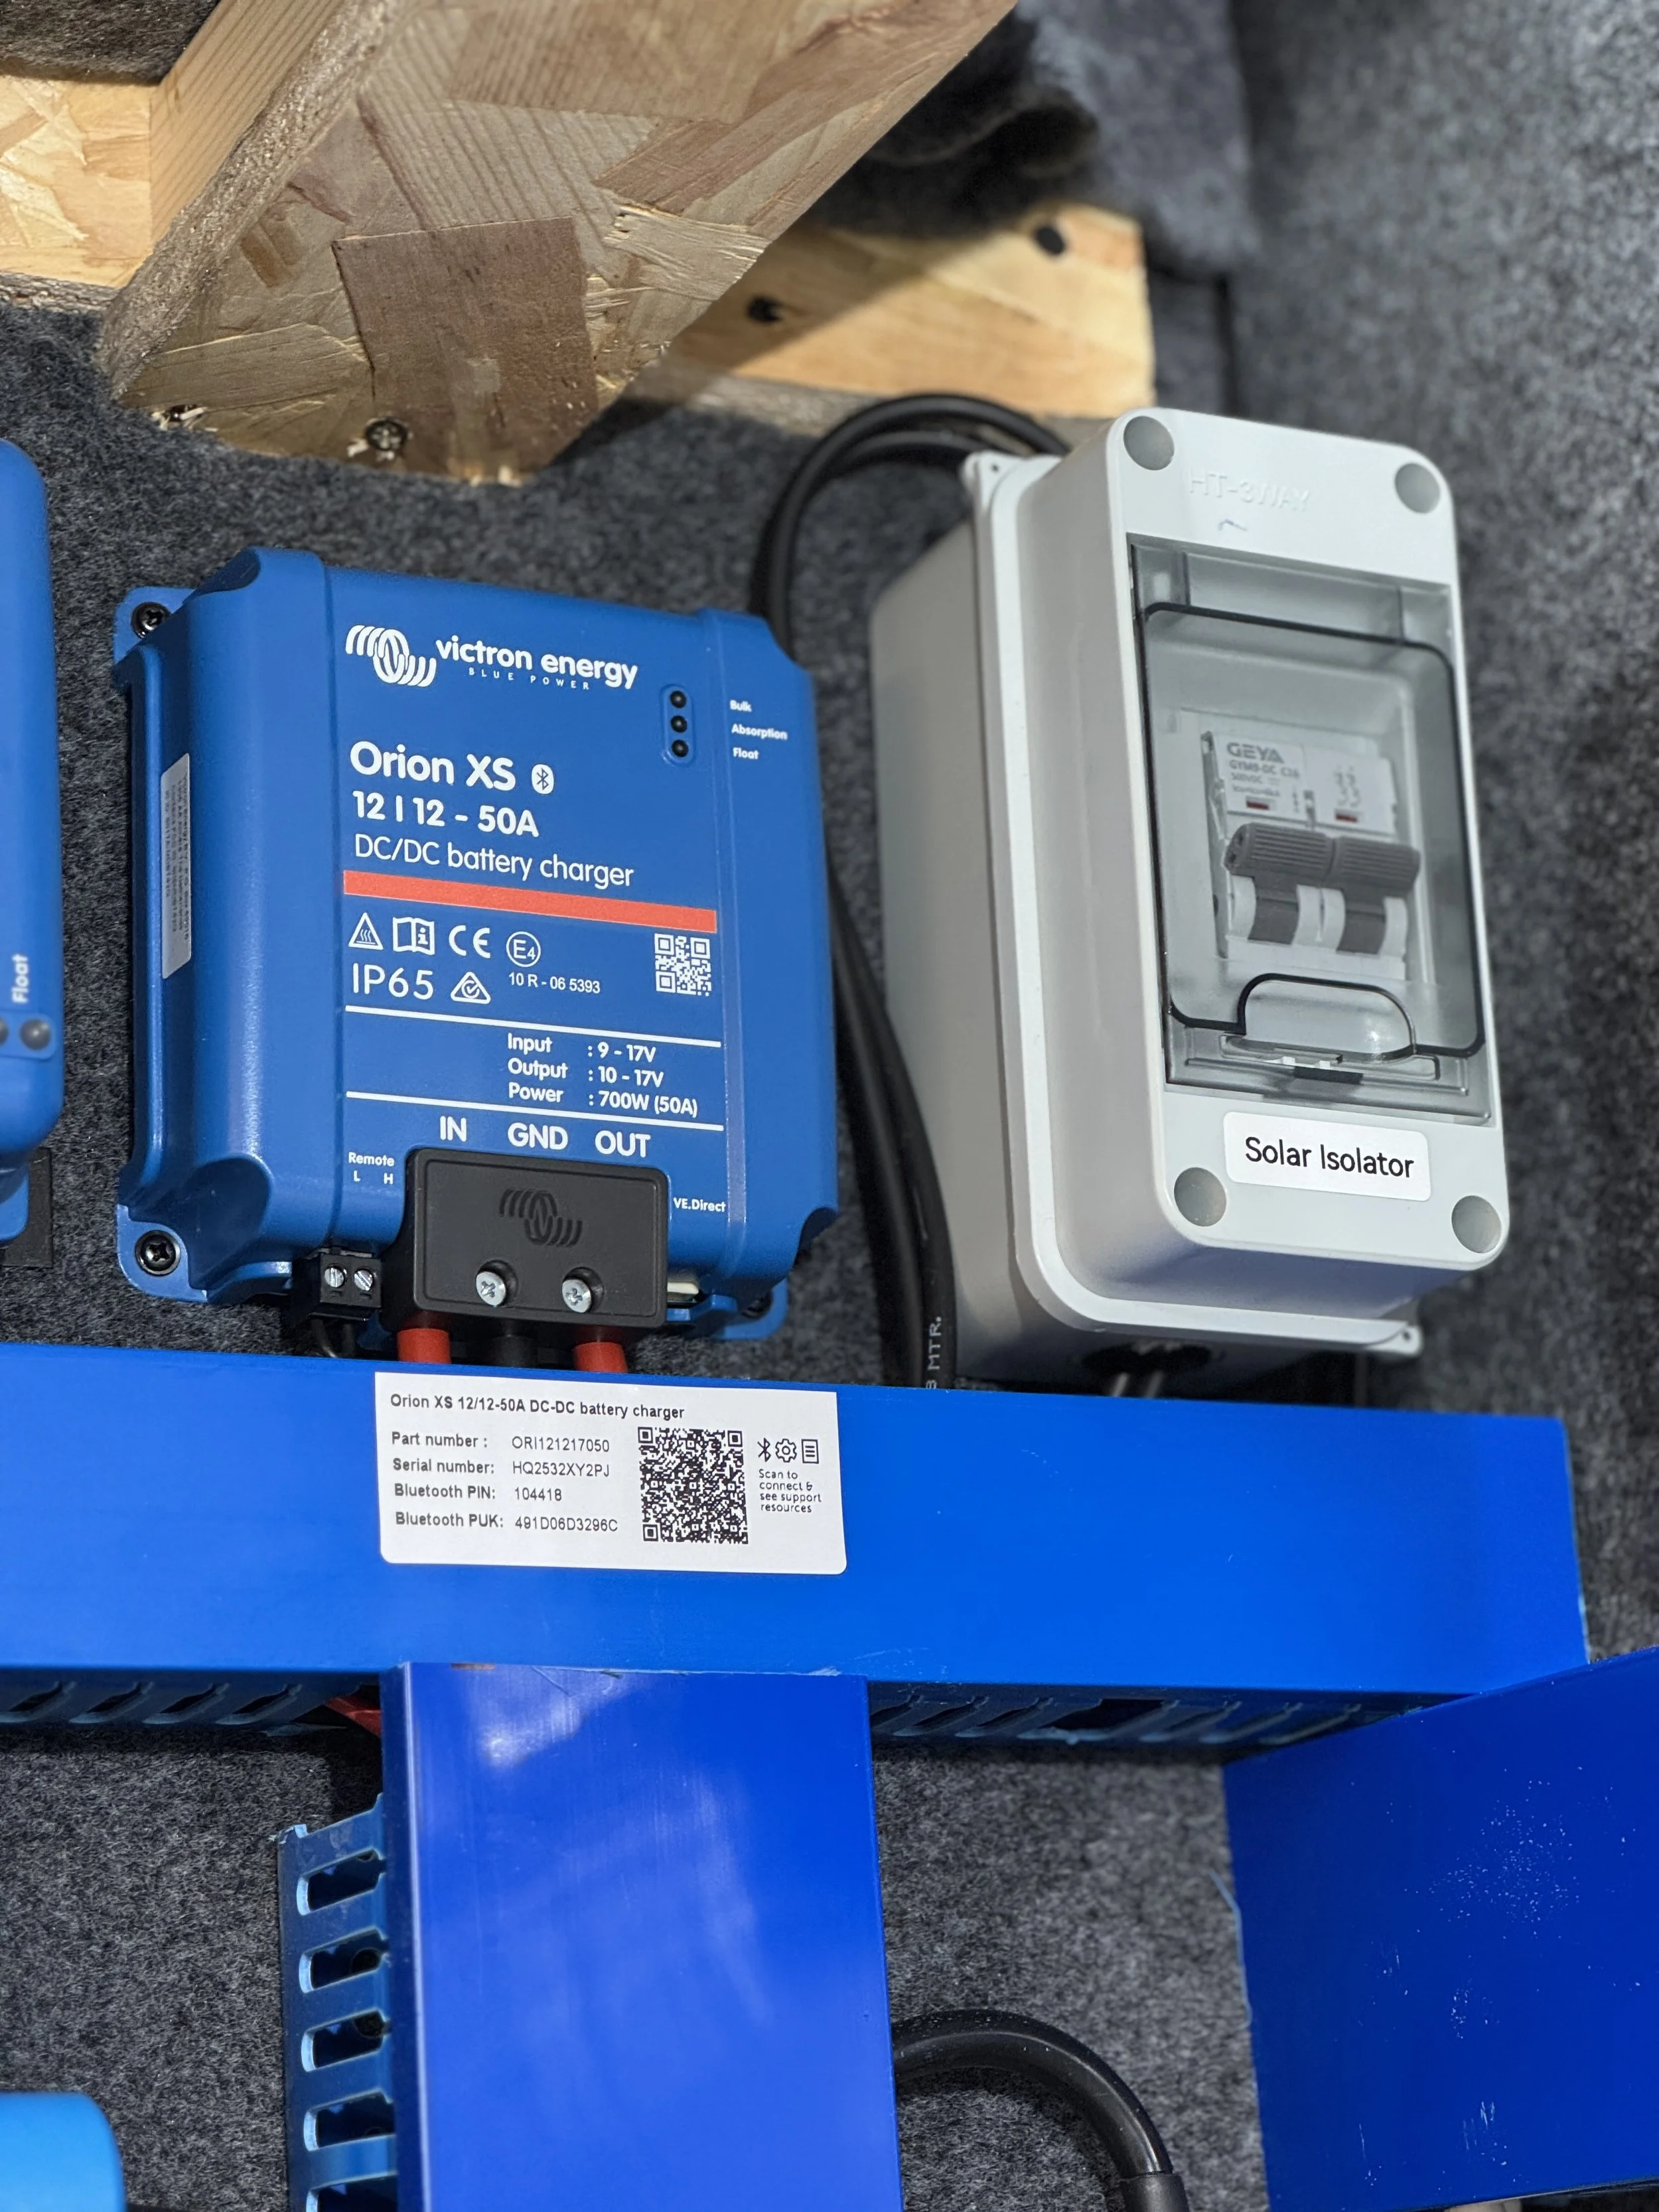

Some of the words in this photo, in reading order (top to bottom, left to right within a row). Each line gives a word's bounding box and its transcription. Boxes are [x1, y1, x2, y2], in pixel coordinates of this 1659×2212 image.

[435, 634, 533, 670] victron
[540, 654, 638, 690] energy
[469, 667, 514, 681] BLUE
[530, 675, 589, 690] POWER
[730, 700, 752, 712] Bulk
[731, 723, 788, 740] Absorption
[733, 747, 759, 760] Float
[1226, 742, 1284, 763] GEYA
[350, 741, 455, 784] Orion
[466, 754, 516, 791] XS
[352, 790, 386, 820] 12
[412, 797, 445, 827] 12
[477, 805, 540, 838] 50A
[355, 833, 440, 865] DC/DC
[447, 842, 533, 881] battery
[540, 853, 634, 890] charger
[11, 954, 29, 1003] Float
[352, 963, 434, 1000] IP65
[508, 972, 524, 986] 10
[528, 974, 538, 988] R
[549, 976, 566, 990] 06
[569, 978, 601, 994] 5393
[508, 1033, 553, 1055] Input
[597, 1041, 609, 1059] 9
[626, 1044, 656, 1063] 17V
[508, 1057, 569, 1081] Output
[598, 1065, 617, 1084] 10
[634, 1069, 664, 1088] 17V
[508, 1082, 564, 1103] Power
[598, 1090, 650, 1111] 700W
[654, 1095, 698, 1118] (50A)
[440, 1116, 467, 1142] IN
[507, 1122, 568, 1150] GND
[595, 1130, 651, 1158] OUT
[348, 1151, 395, 1167] Remote
[1246, 1136, 1312, 1167] Solar
[1320, 1143, 1415, 1178] Isolator
[353, 1170, 360, 1182] L
[384, 1173, 394, 1185] H
[673, 1197, 727, 1213] VE.Direct
[927, 1316, 942, 1370] MTR.
[390, 1393, 429, 1408] Orion
[434, 1395, 453, 1409] XS
[458, 1396, 526, 1412] 12/12-50A
[530, 1399, 575, 1414] DC-DC
[580, 1401, 628, 1420] battery
[632, 1404, 685, 1422] charger
[392, 1431, 420, 1445] Part
[425, 1434, 478, 1447] number
[512, 1436, 610, 1453] ORI121217050
[393, 1457, 432, 1472] Serial
[437, 1459, 494, 1474] number:
[512, 1461, 609, 1477] HQ2532XY2PJ
[758, 1468, 784, 1479] Scan
[787, 1470, 798, 1480] to
[394, 1483, 463, 1499] Bluetooth
[467, 1485, 495, 1499] PIN:
[759, 1482, 803, 1491] connect
[760, 1493, 777, 1501] see
[780, 1493, 822, 1504] support
[760, 1504, 812, 1513] resources
[396, 1511, 464, 1526] Bluetooth
[469, 1513, 503, 1528] PUK:
